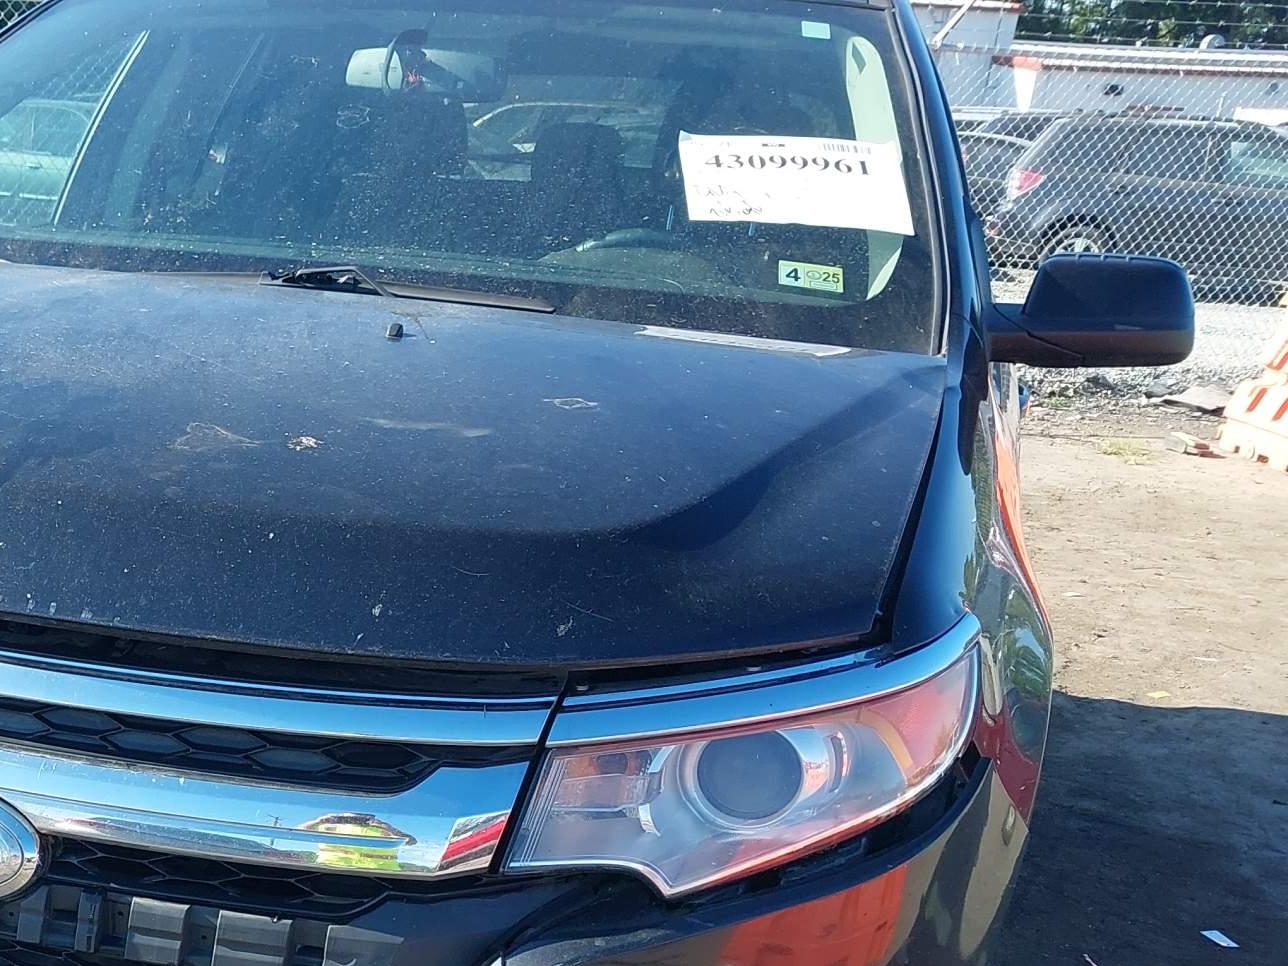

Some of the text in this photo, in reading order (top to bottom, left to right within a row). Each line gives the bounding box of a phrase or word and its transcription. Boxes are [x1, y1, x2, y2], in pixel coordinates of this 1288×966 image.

[705, 154, 871, 176] 43099961
[785, 267, 840, 284] 4 25
